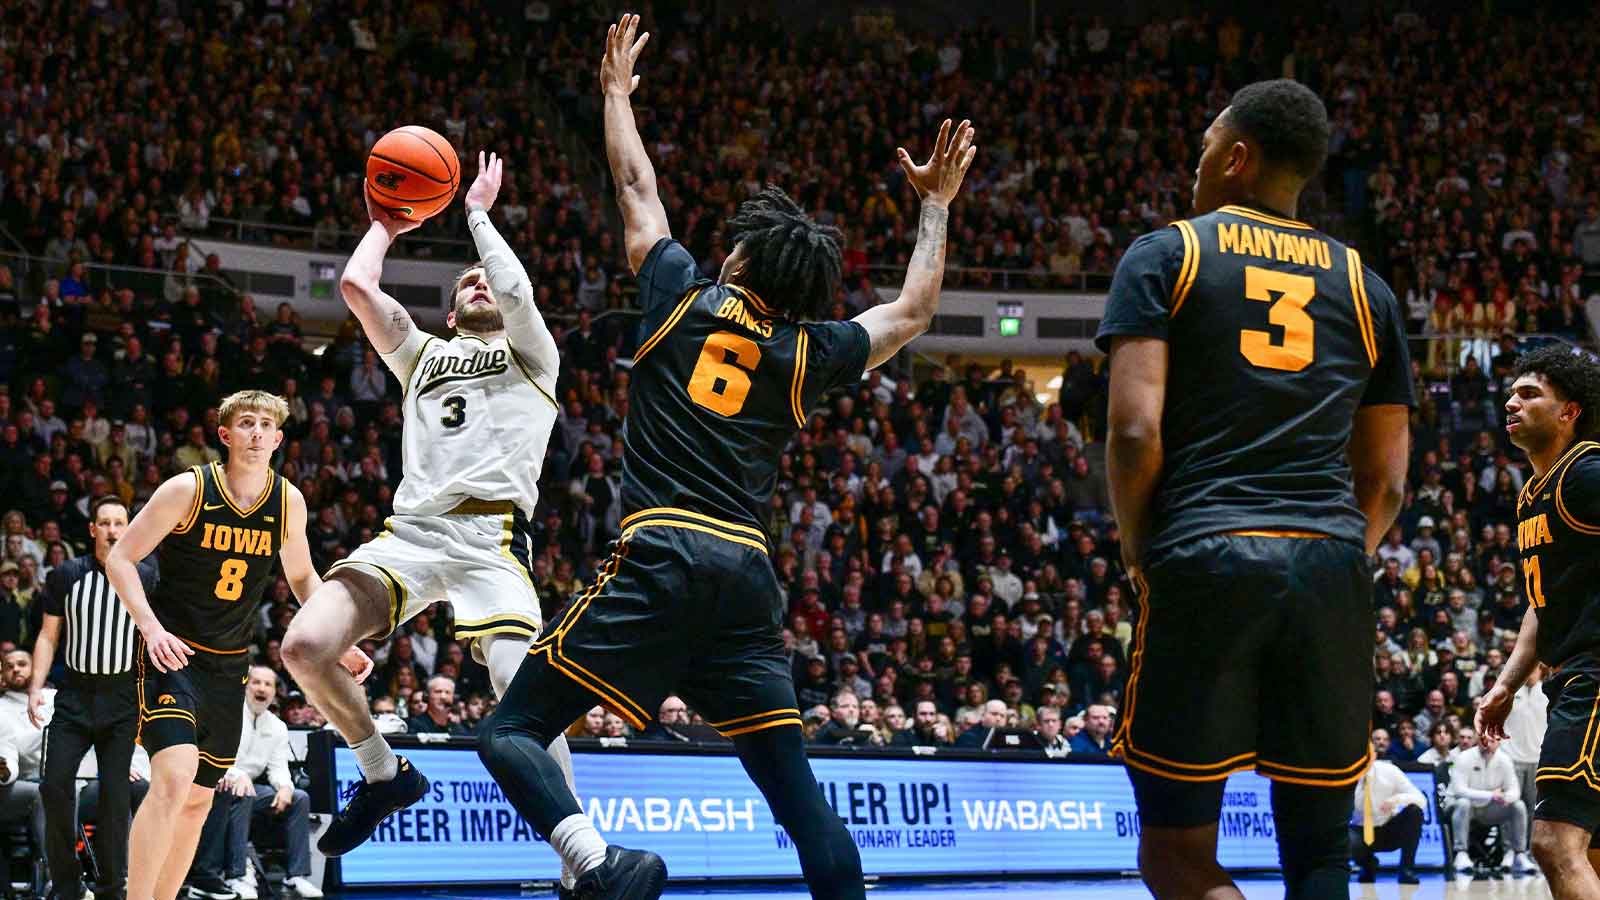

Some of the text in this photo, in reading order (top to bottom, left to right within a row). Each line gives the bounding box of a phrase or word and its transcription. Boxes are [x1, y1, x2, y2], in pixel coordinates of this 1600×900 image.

[1217, 223, 1332, 270] MANYAWU
[717, 296, 773, 338] BANKS
[1240, 266, 1316, 372] 3
[415, 349, 509, 396] Purdue
[687, 330, 762, 417] 6
[440, 395, 467, 428] 3
[201, 522, 273, 557] IOWA
[214, 558, 249, 601] 8
[450, 781, 507, 803] TOWA
[900, 782, 952, 825] UP!
[575, 797, 755, 832] WABASH
[962, 800, 1103, 831] WABASH
[908, 829, 957, 848] LEADER
